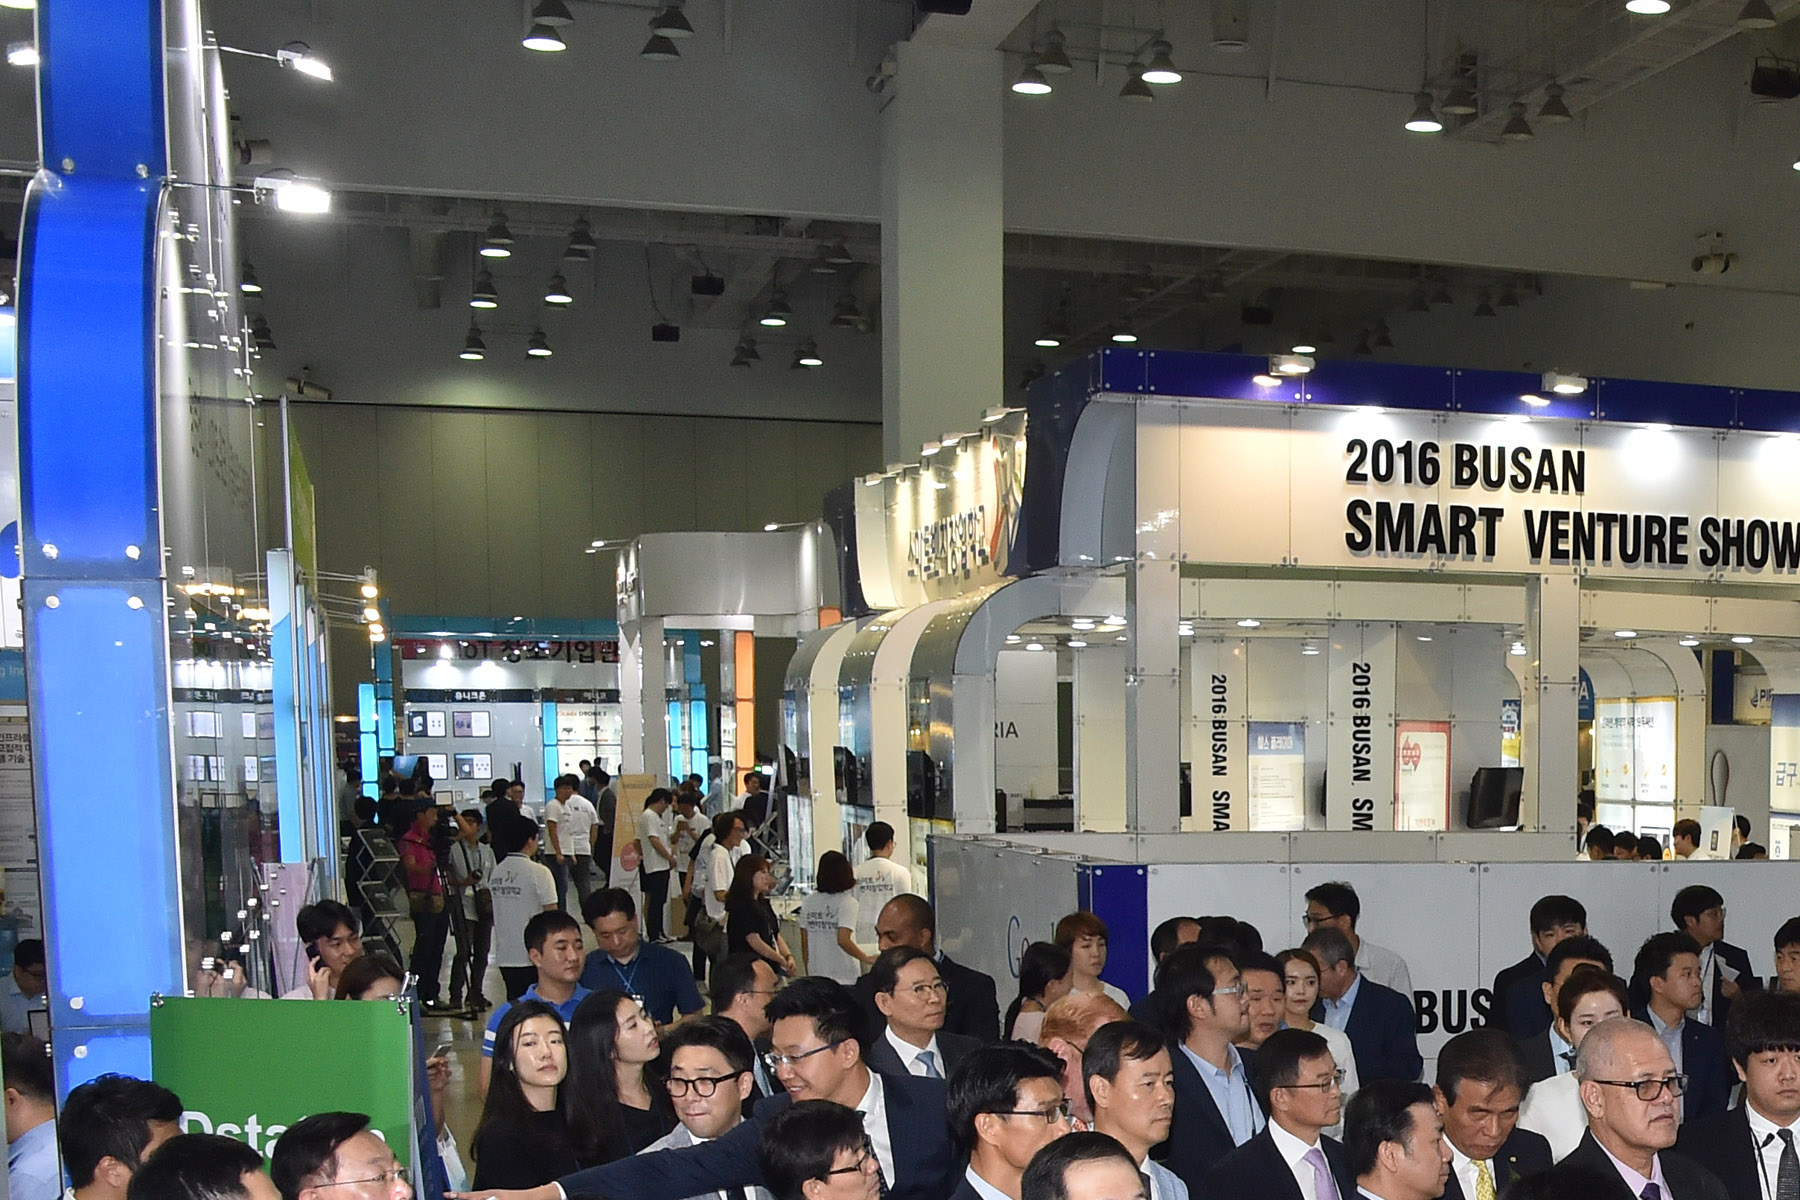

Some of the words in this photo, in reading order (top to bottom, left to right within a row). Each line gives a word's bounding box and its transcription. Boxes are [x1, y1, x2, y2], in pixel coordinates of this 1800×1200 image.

[1346, 439, 1441, 487] 2016
[1453, 444, 1586, 494] BUSAN
[1345, 500, 1504, 557] SMART
[1524, 510, 1689, 566] VENTURE
[1212, 675, 1227, 714] 2016
[1352, 663, 1371, 709] 2016
[1212, 720, 1227, 776] BUSAN
[1352, 716, 1371, 781] BUSAN
[1776, 762, 1798, 787] 급구
